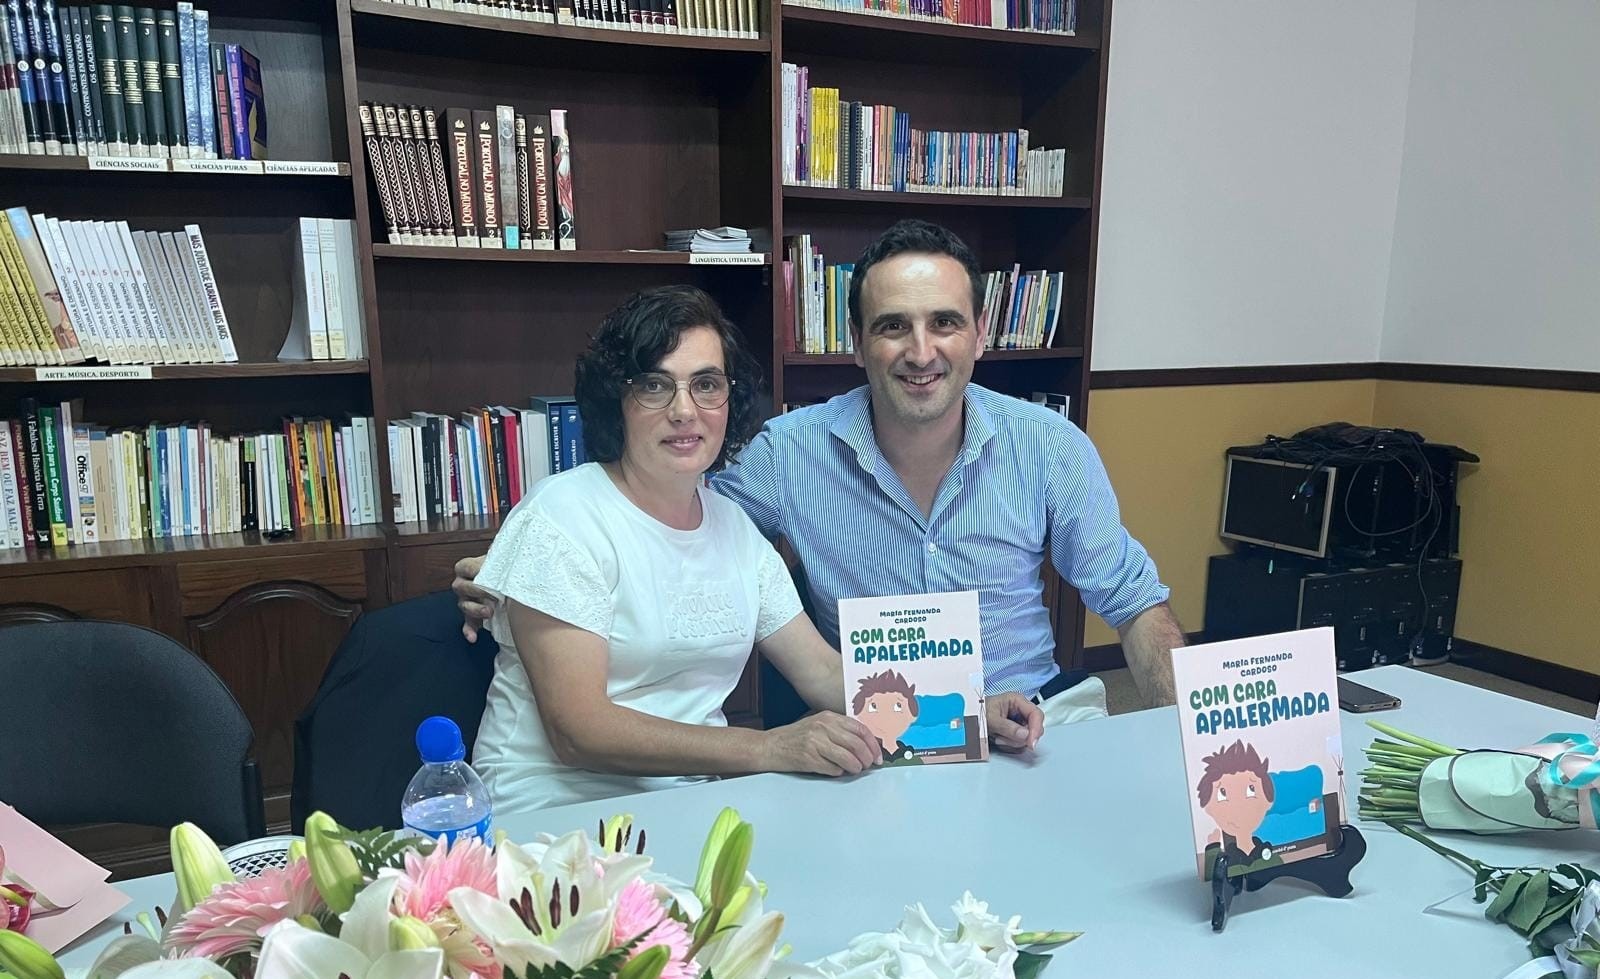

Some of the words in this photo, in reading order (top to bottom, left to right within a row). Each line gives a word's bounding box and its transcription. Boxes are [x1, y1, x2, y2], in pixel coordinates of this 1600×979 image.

[102, 24, 106, 32] 1
[123, 26, 128, 34] 2
[65, 34, 77, 81] TERRAMOTOS
[84, 34, 96, 72] GLACIARES
[78, 63, 85, 73] EM
[90, 73, 97, 84] OS
[71, 83, 78, 93] OS
[80, 74, 92, 117] CONTINENTES
[96, 160, 129, 168] CIÊNCIAS
[266, 164, 298, 172] CIÊNCIAS
[454, 136, 470, 178] PORTUGAL
[479, 138, 495, 180] PORTUGAL
[534, 143, 547, 182] PORTUGAL
[459, 178, 470, 191] NO
[484, 180, 494, 192] NO
[536, 183, 546, 194] NO
[459, 191, 474, 223] MUNDO
[483, 191, 497, 224] MUNDO
[536, 195, 548, 226] MUNDO
[190, 234, 202, 249] MAIS
[540, 232, 546, 240] 3
[194, 249, 212, 282] JUVENTUDE
[58, 275, 75, 303] DESENHO
[71, 279, 87, 307] DESENHO
[85, 282, 100, 310] DESENHO
[96, 282, 111, 310] DESENHO
[108, 281, 122, 309] DESENHO
[119, 282, 133, 309] DESENHO
[129, 282, 145, 310] DESENHO
[141, 282, 156, 310] DESENHO
[204, 282, 220, 310] DURANTE
[71, 308, 86, 333] PINTURA
[83, 313, 98, 336] PINTURA
[97, 315, 111, 339] PINTURA
[108, 315, 121, 339] PINTURA
[120, 314, 132, 338] PINTURA
[131, 315, 144, 338] PINTURA
[141, 315, 155, 339] PINTURA
[153, 315, 166, 339] PINTURA
[212, 309, 224, 325] MAIS
[217, 324, 229, 340] ANOS
[27, 421, 40, 452] Fabulosa
[42, 416, 57, 453] Alimentação
[0, 451, 10, 470] BEM
[31, 453, 43, 481] História
[46, 453, 55, 466] para
[76, 455, 89, 484] Office
[3, 473, 12, 486] OU
[49, 467, 57, 477] um
[4, 488, 14, 505] FAZ
[36, 482, 43, 491] da
[49, 478, 61, 496] Corpo
[79, 484, 89, 494] 97
[37, 493, 46, 510] Terra
[52, 496, 64, 522] Saudável
[7, 508, 18, 532] MAL?
[895, 616, 927, 624] CARDOSO
[904, 608, 941, 616] FERNANDA
[850, 628, 884, 645] COM
[888, 627, 925, 643] CARA
[854, 638, 973, 664] APALERMADA
[1250, 652, 1293, 666] FERNANDA
[1241, 664, 1277, 677] CARDOSO
[1189, 684, 1229, 710] COM
[1234, 679, 1277, 704] CARA
[1196, 691, 1330, 735] APALERMADA
